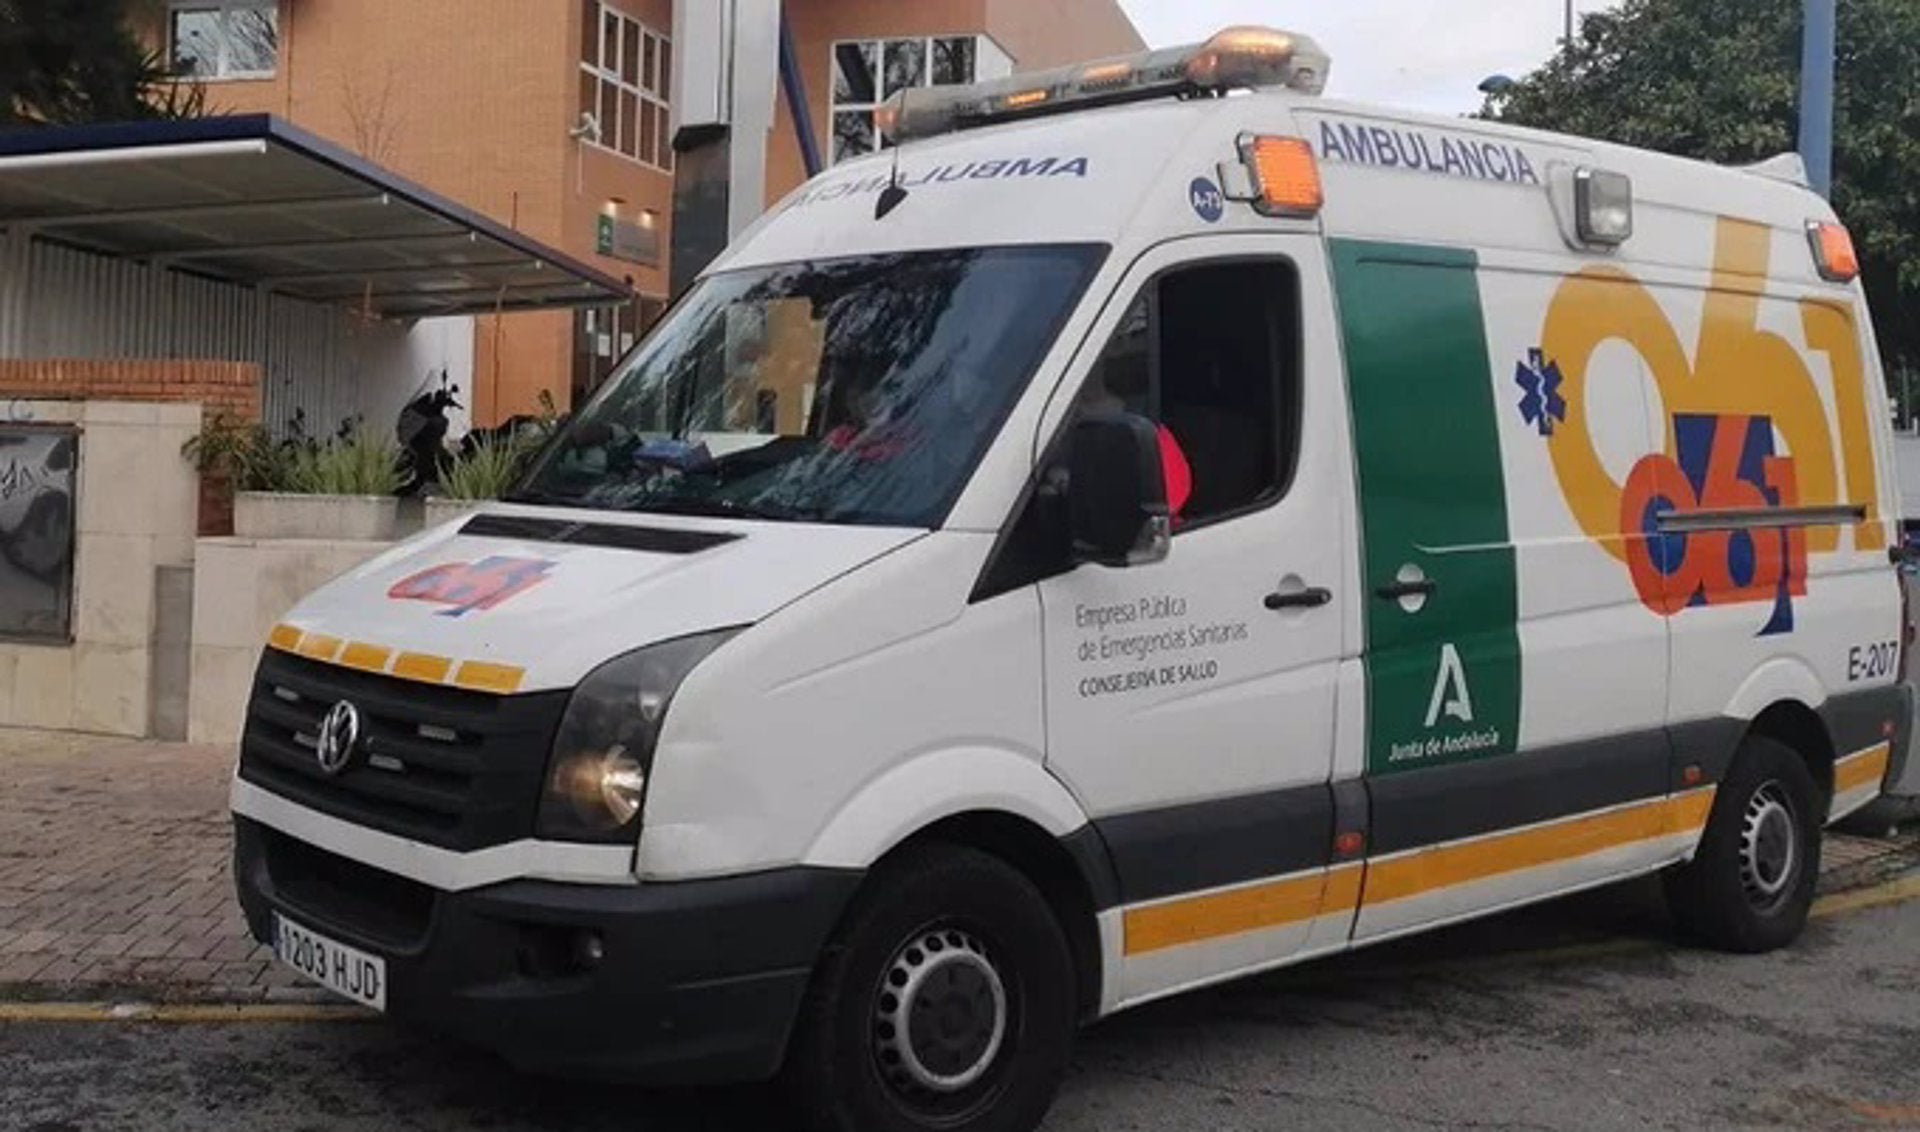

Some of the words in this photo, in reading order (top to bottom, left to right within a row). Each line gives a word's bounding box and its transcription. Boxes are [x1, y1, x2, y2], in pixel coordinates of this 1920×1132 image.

[1319, 120, 1539, 185] AMBULANCIA
[1075, 602, 1136, 630] Empresa
[1140, 595, 1187, 619] Pública
[1078, 640, 1096, 661] de
[1100, 629, 1186, 661] Emergencias
[1848, 640, 1898, 681] E-207
[1160, 665, 1176, 685] DE
[1179, 660, 1218, 683] SALUD
[1388, 742, 1424, 762] Junta
[1426, 736, 1441, 756] de
[284, 924, 326, 979] 1203
[332, 950, 378, 1000] HJD
